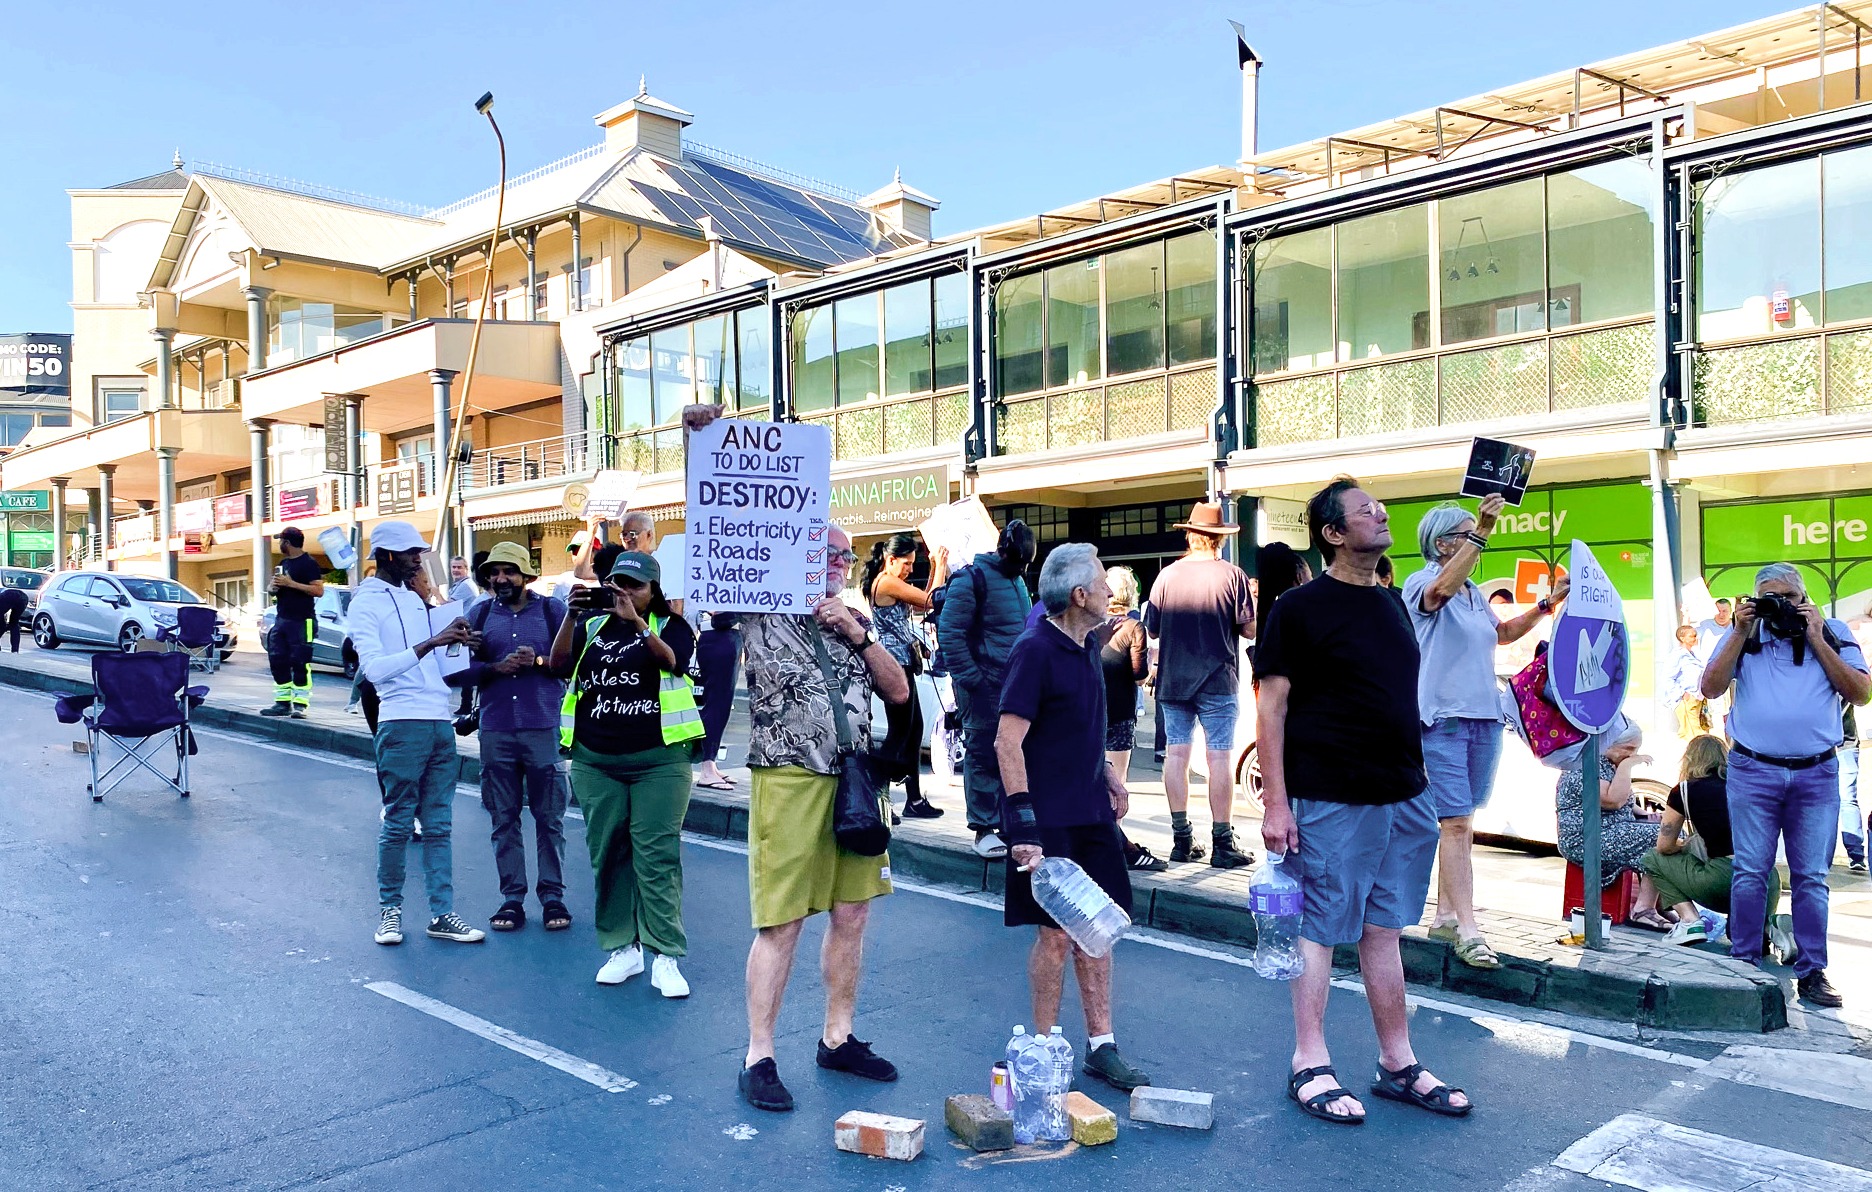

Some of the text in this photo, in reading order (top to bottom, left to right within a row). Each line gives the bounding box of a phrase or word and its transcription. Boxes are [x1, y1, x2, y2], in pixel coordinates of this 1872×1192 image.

[19, 343, 62, 355] CODE:
[0, 357, 63, 377] IN50
[721, 425, 782, 452] ANC
[711, 452, 805, 473] TO DO LIST
[8, 496, 37, 507] CAFE
[699, 481, 817, 513] DESTROY:
[828, 474, 939, 509] ANNAFRICA
[873, 506, 934, 522] Reimagine
[694, 516, 803, 546] 1. Electricity
[1783, 514, 1867, 546] here
[692, 539, 771, 562] 2. Roads
[691, 561, 770, 583] 3. Water
[1581, 565, 1589, 580] IS
[690, 583, 793, 611] 4. Railways
[1581, 584, 1613, 608] RIGHT!
